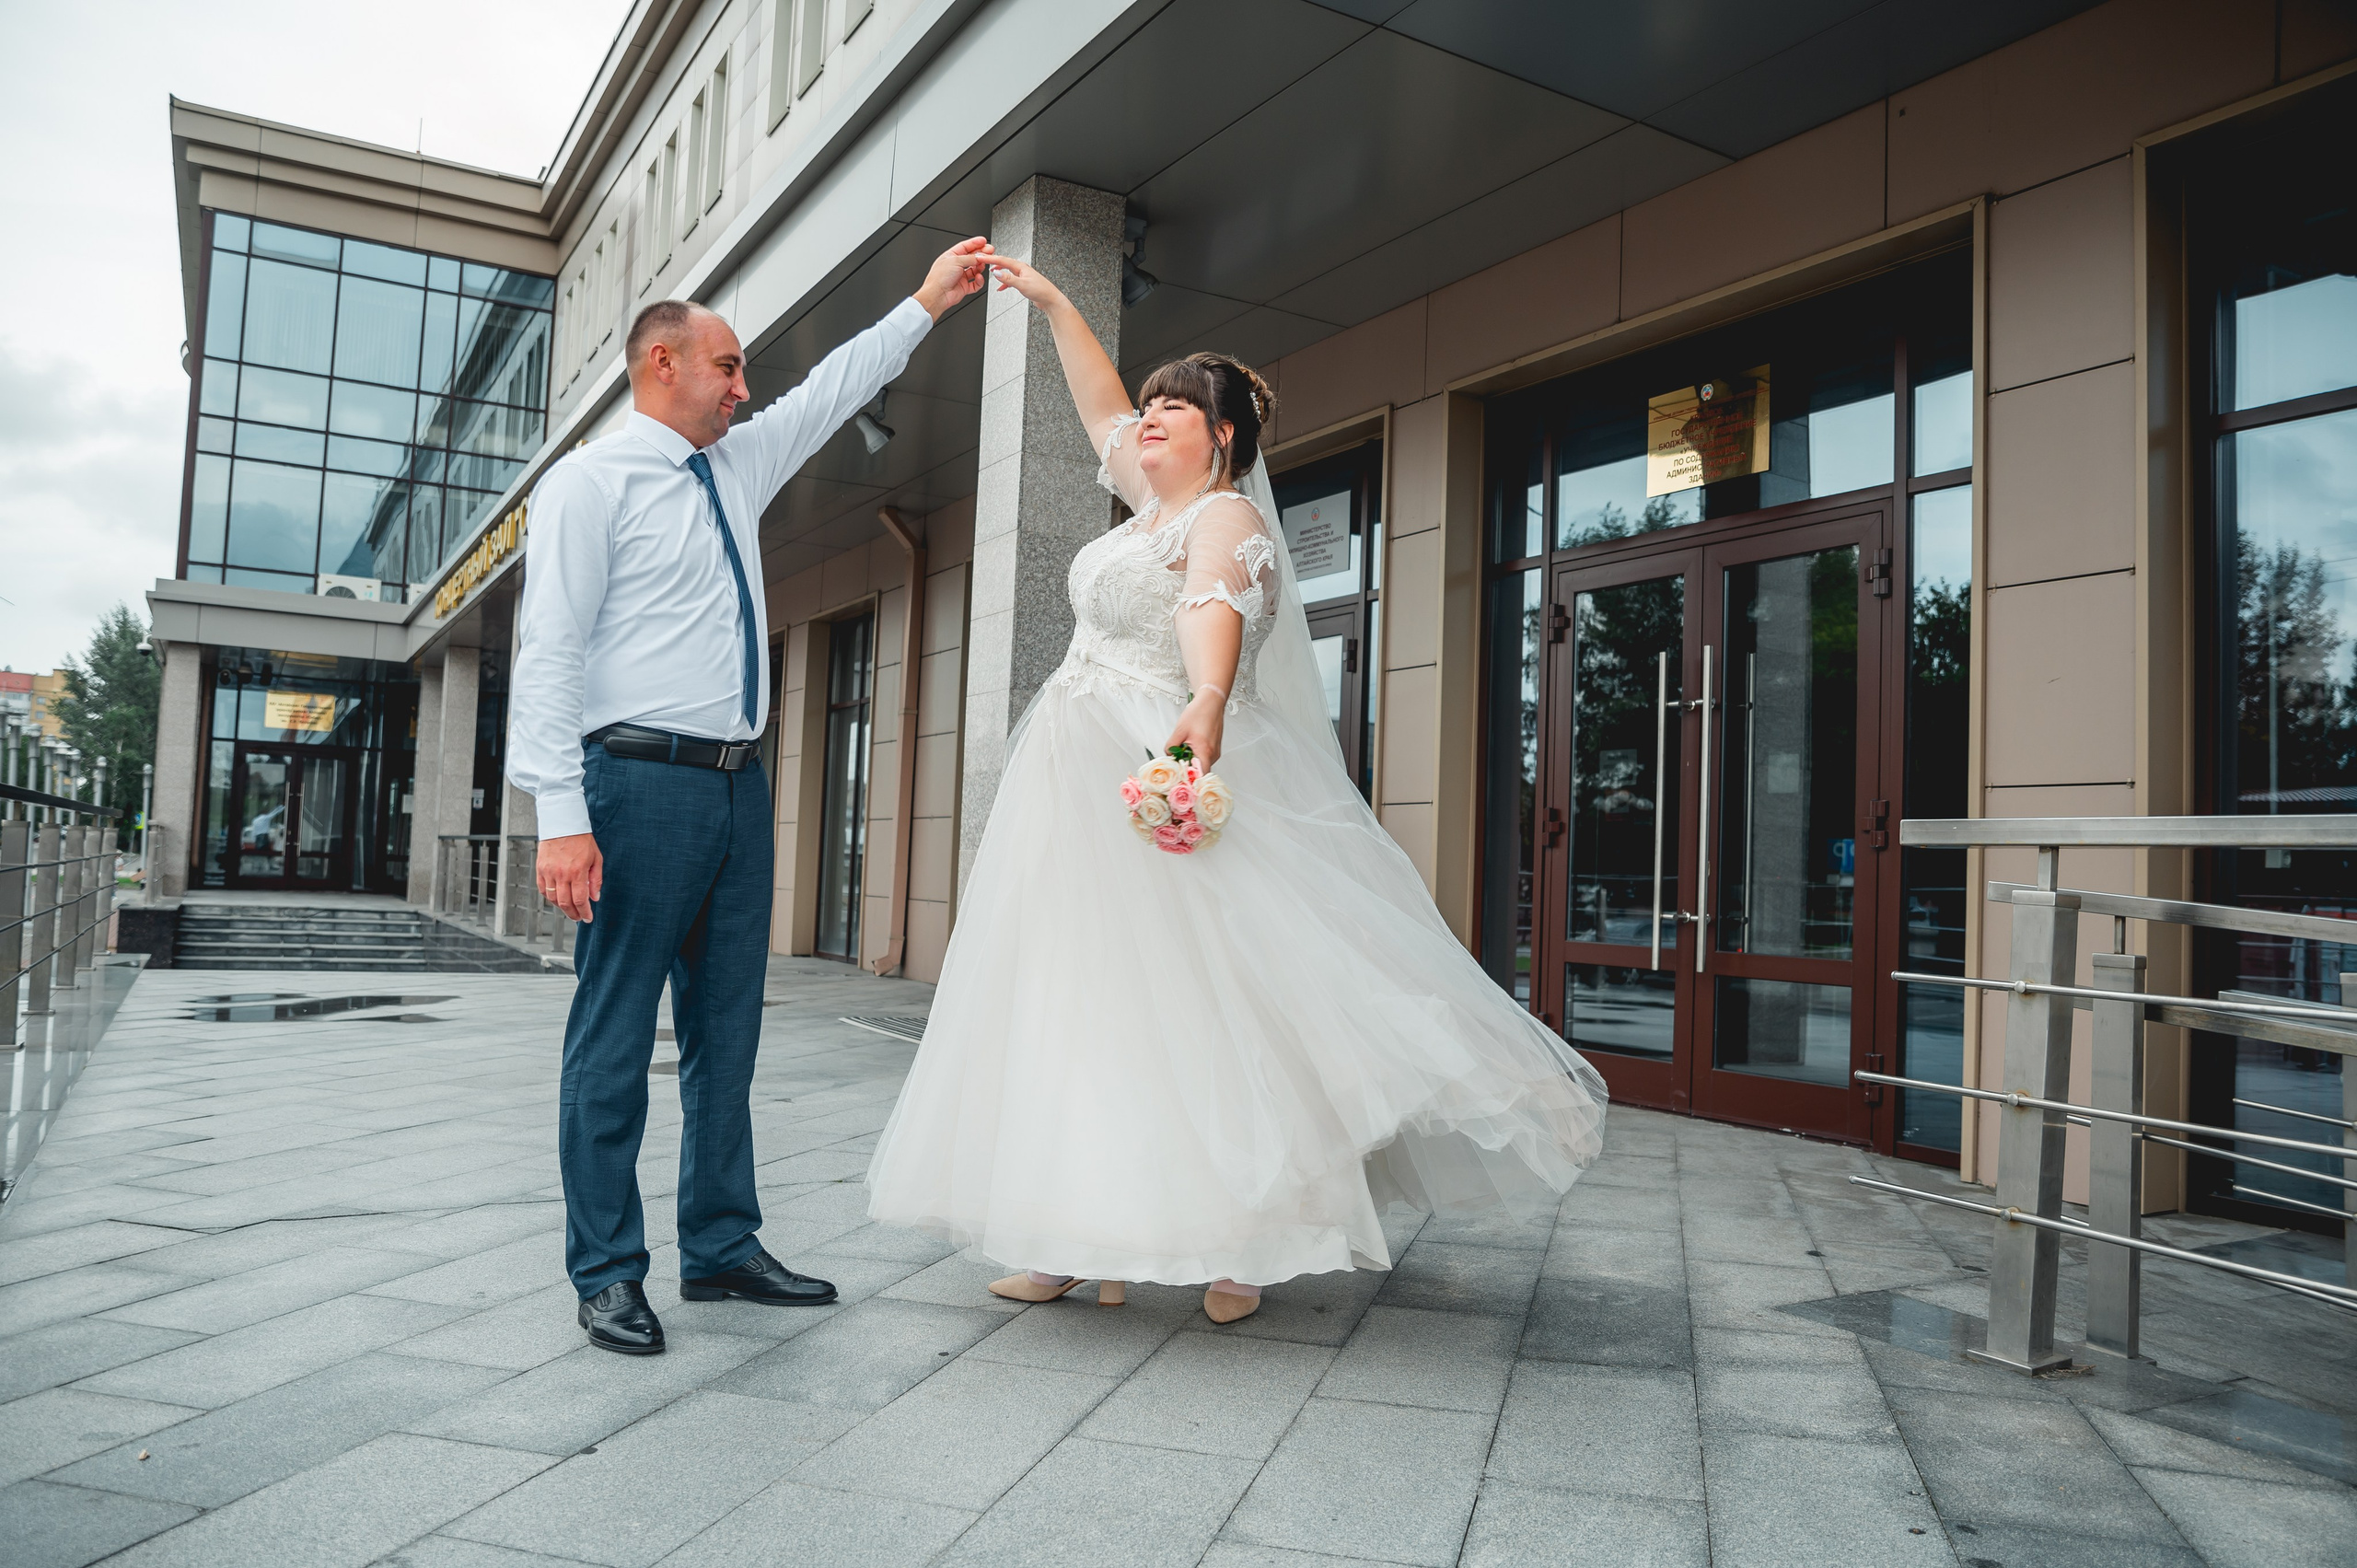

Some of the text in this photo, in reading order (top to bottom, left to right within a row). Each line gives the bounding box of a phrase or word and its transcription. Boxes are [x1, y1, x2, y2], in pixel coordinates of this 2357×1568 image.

[1658, 433, 1704, 450] БЮДЖЕТНОЕ
[1673, 458, 1684, 467] ПО
[1299, 523, 1331, 536] МИНИСТЕРСТВО
[489, 512, 516, 565] ЗАЛ
[1296, 531, 1329, 544] СТРОИТЕЛЬСТВА
[1296, 556, 1322, 567] АЛТАЙСКОГО
